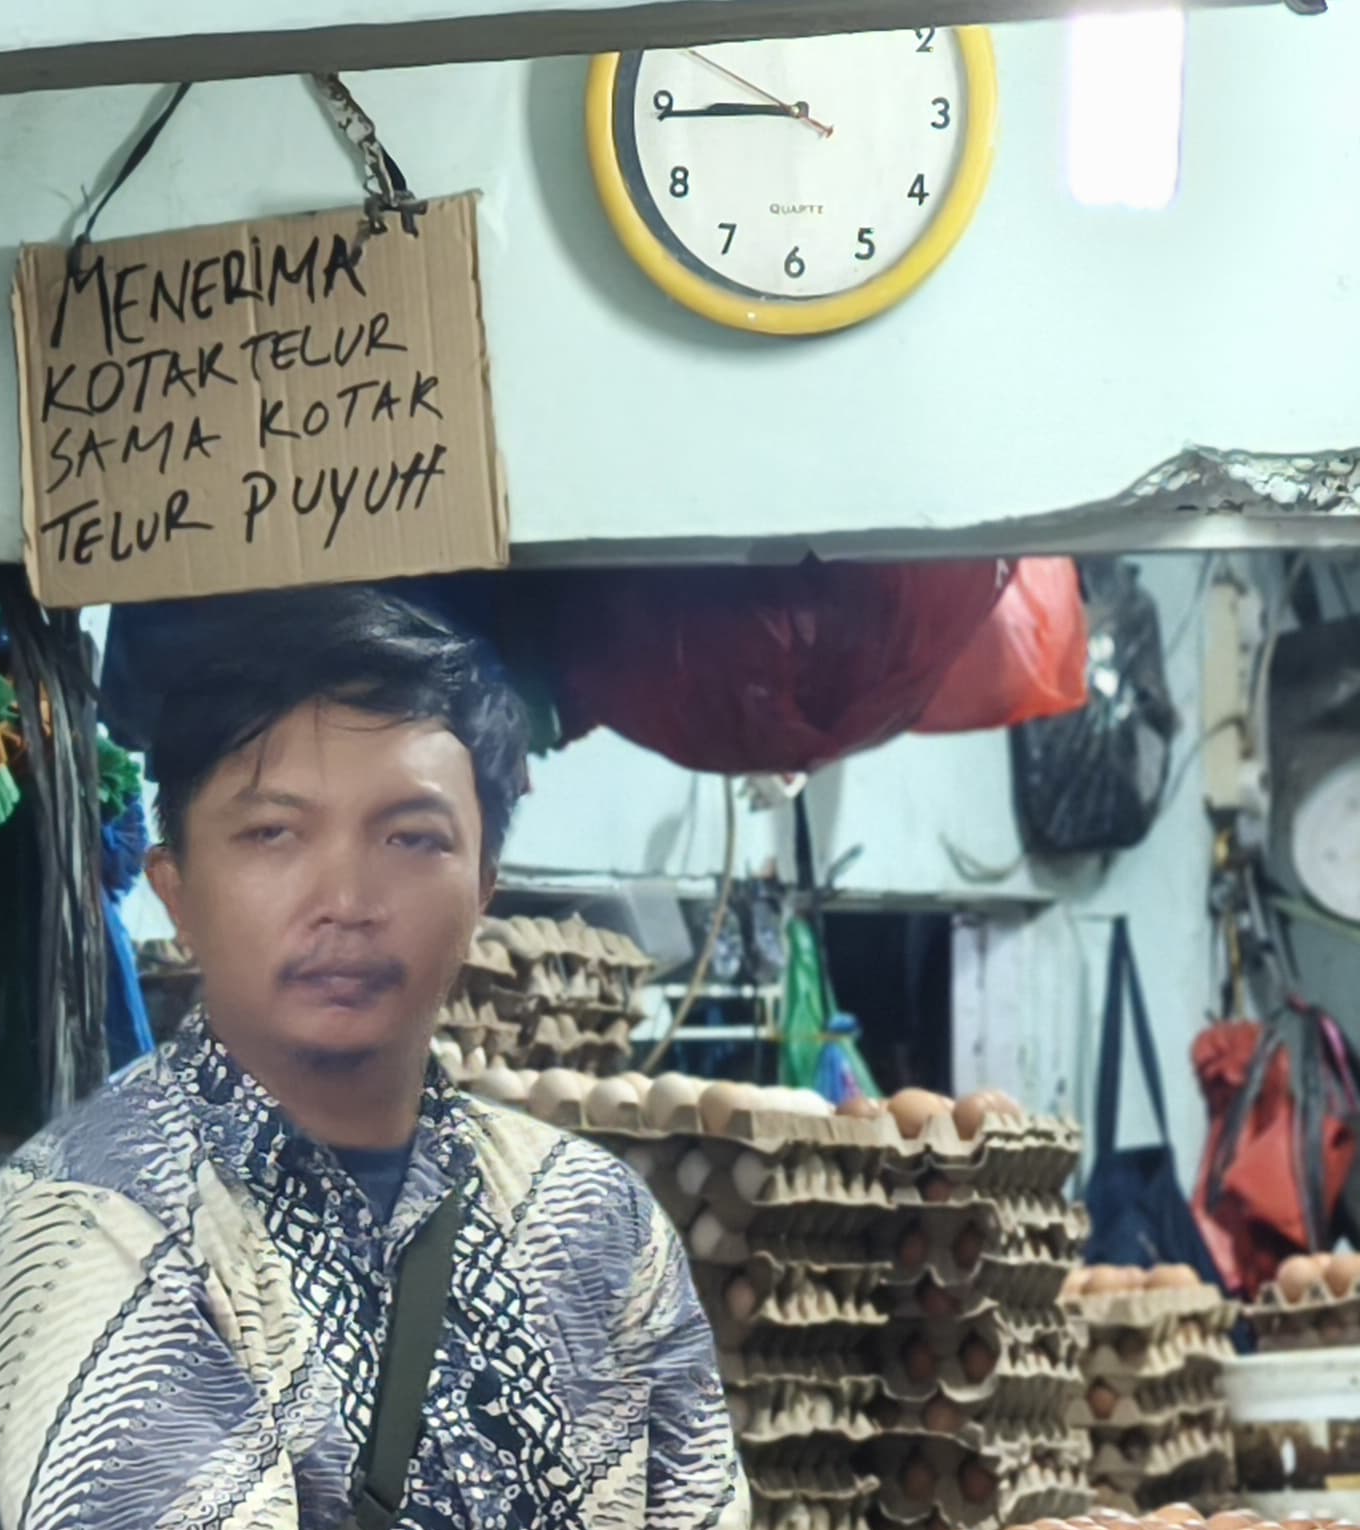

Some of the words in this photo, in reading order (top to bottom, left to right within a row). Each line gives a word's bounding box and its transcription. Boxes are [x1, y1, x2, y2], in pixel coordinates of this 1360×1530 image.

[652, 90, 674, 121] 9
[930, 97, 951, 129] 3
[669, 166, 690, 198] 8
[907, 174, 930, 206] 4
[718, 223, 737, 255] 7
[854, 228, 876, 261] 5
[784, 247, 805, 279] 6
[50, 235, 367, 355] MENERIMA
[40, 343, 239, 423] KOTAK
[240, 312, 407, 382] TELUR
[46, 416, 222, 493] SAMA
[259, 371, 444, 448] KOTAK
[41, 489, 214, 564] TELUR
[242, 444, 447, 549] PUYUH
